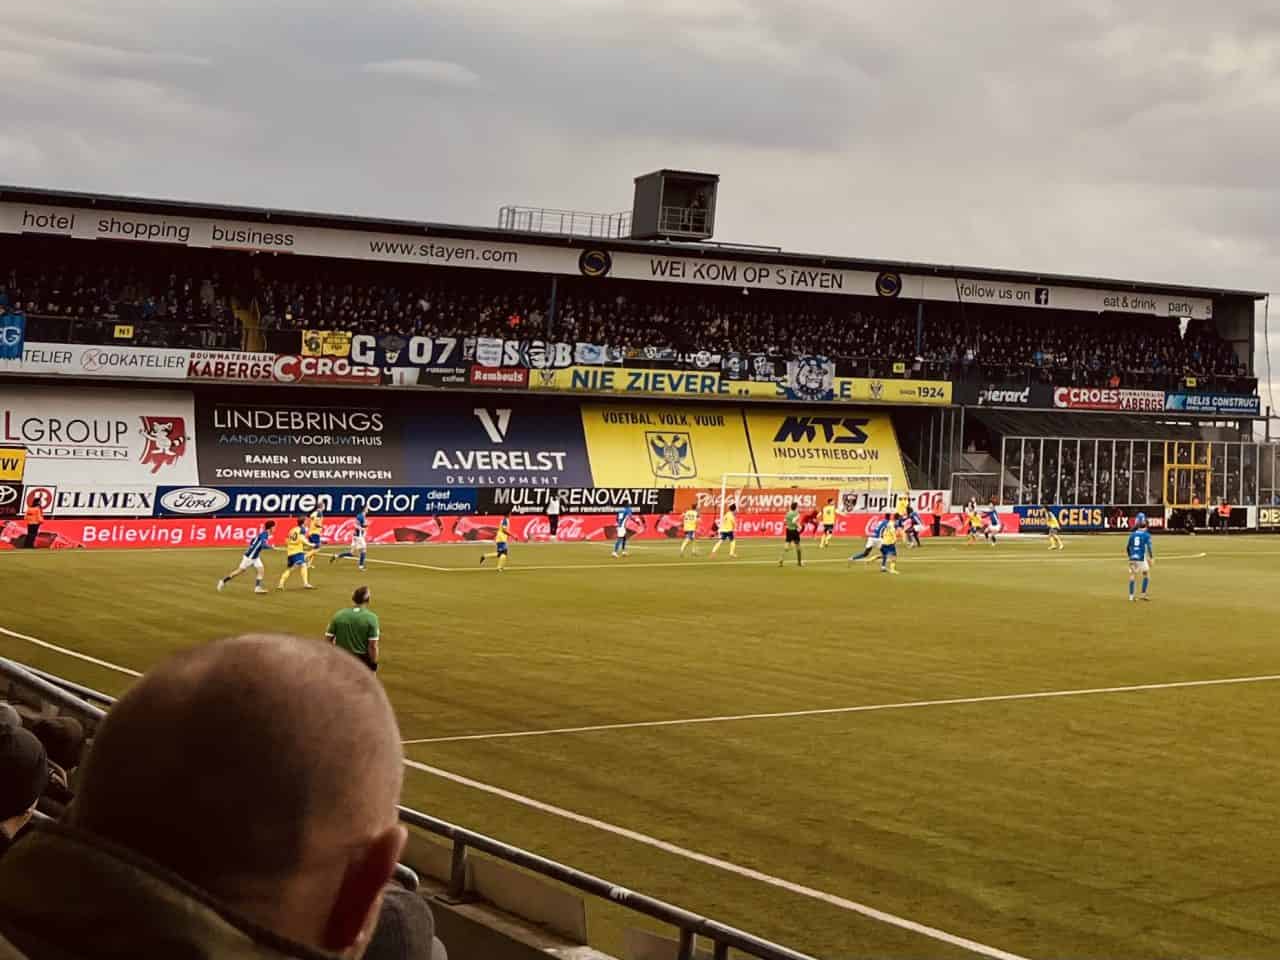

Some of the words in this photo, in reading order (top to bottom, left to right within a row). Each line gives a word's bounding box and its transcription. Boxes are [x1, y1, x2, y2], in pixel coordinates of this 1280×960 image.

[22, 210, 75, 230] hotel
[98, 218, 191, 241] shopping
[212, 225, 294, 246] business
[369, 240, 518, 264] www.stayen.com
[743, 268, 770, 283] OP
[776, 270, 843, 289] STAYEN
[960, 283, 995, 298] follow
[1000, 289, 1012, 299] us
[1016, 290, 1030, 300] on
[1104, 296, 1119, 307] eat
[1131, 297, 1156, 310] drink
[1168, 302, 1193, 315] party
[22, 349, 73, 364] TELIER
[190, 352, 274, 362] BOUWMATERIALEN
[187, 361, 274, 379] KABERGS
[301, 358, 380, 377] CROES
[571, 370, 614, 389] NIE
[626, 373, 750, 395] ZIEVERE
[917, 387, 944, 397] 1924
[978, 386, 1030, 404] pierard
[1070, 389, 1117, 402] CROES
[1187, 395, 1210, 405] NELIS
[214, 410, 384, 432] LINDEBRINGS
[773, 416, 870, 444] MTS
[0, 457, 18, 471] VV
[245, 454, 289, 465] RAMEN
[300, 455, 362, 465] ROLLUIKEN
[432, 450, 567, 471] A.VERELST
[215, 468, 290, 479] ZONWERING
[294, 470, 392, 480] OVERKAPPINGEN
[446, 475, 560, 485] DEVELOPMENT
[174, 493, 217, 508] Ford
[234, 492, 333, 512] morren
[340, 489, 419, 512] motor
[1059, 508, 1102, 526] CELIS
[83, 526, 183, 543] Believing
[191, 525, 206, 539] is
[214, 525, 273, 544] Magi
